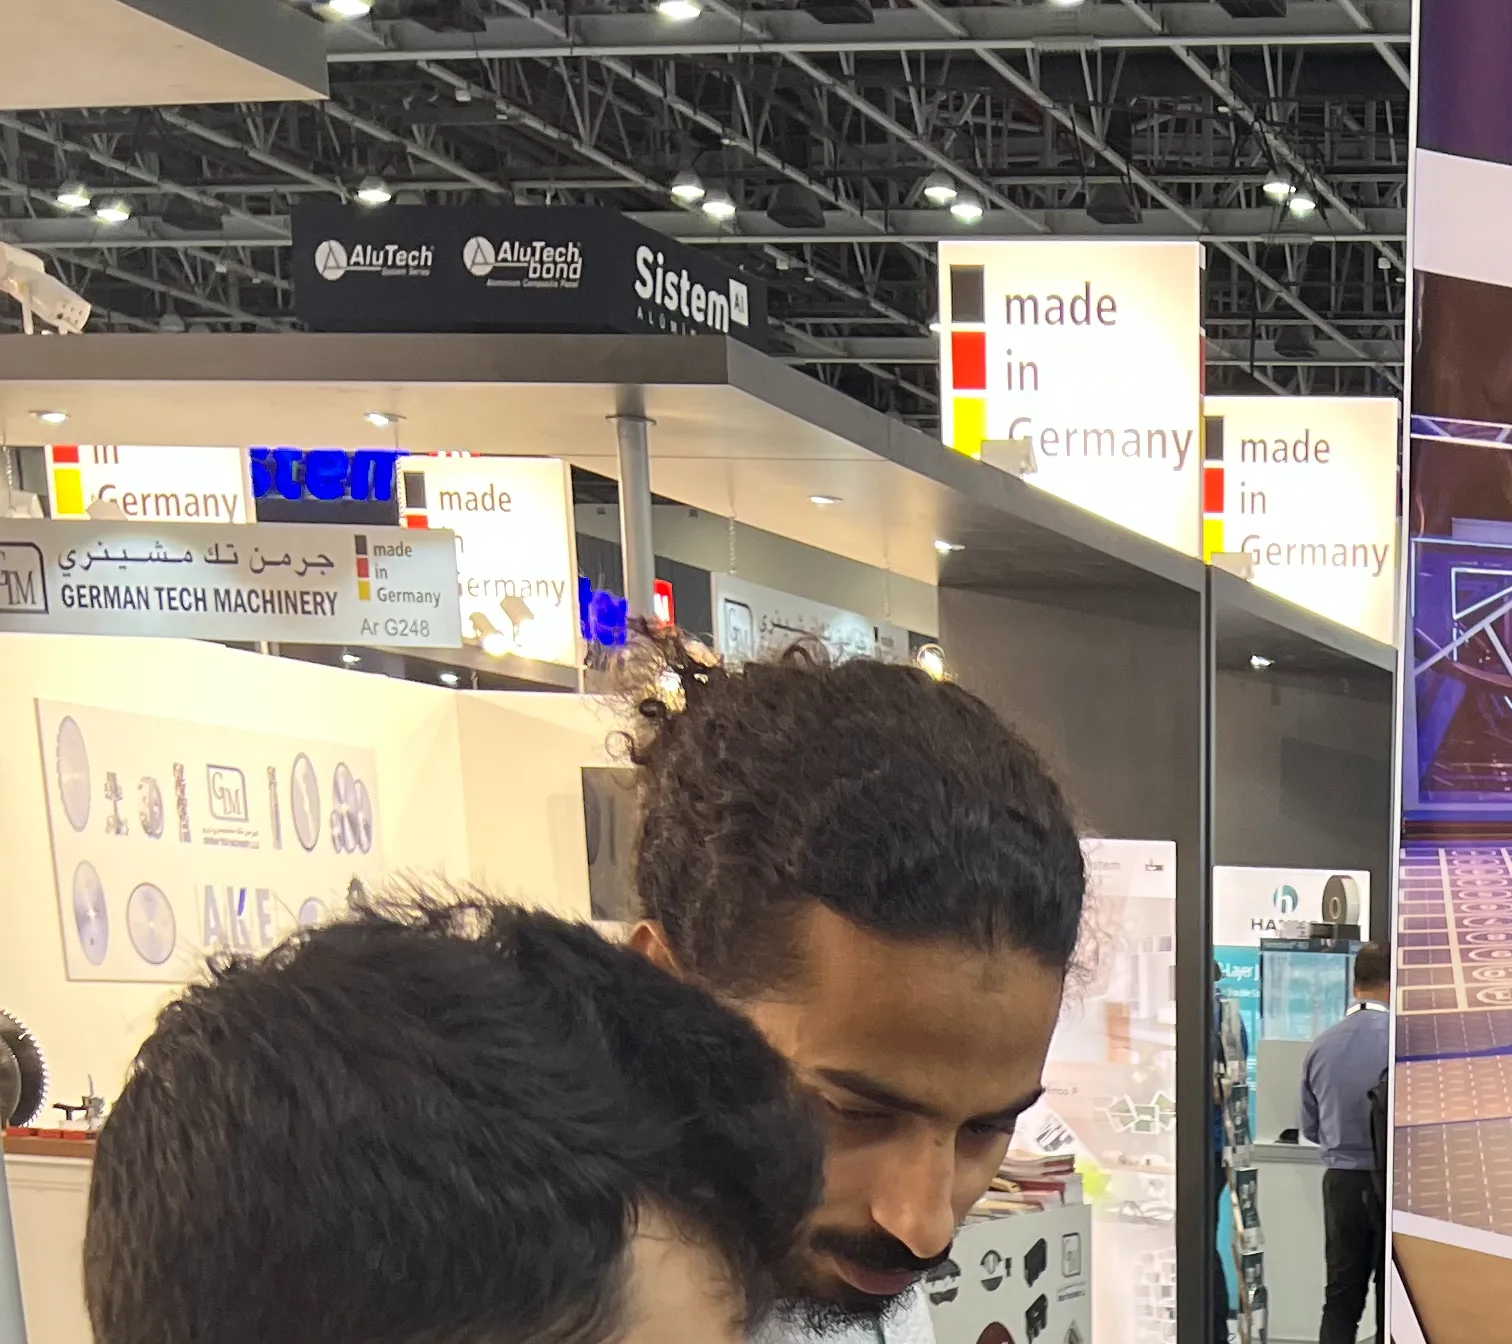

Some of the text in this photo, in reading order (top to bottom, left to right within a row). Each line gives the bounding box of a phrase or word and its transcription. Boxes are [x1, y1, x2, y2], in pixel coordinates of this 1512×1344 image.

[349, 244, 432, 267] AluTech
[497, 240, 581, 263] AluTech
[528, 257, 582, 279] bond
[634, 245, 730, 333] Sistem
[1004, 281, 1118, 326] made
[1005, 348, 1039, 391] in
[1239, 429, 1331, 464] made
[439, 483, 512, 512] made
[1239, 481, 1267, 515] in
[57, 540, 334, 577] جرمن تك مشينري
[373, 541, 413, 557] made
[1240, 535, 1390, 577] Germany
[374, 564, 388, 580] in
[61, 584, 338, 616] GERMAN TECH MACHINERY
[376, 587, 441, 608] Germany
[458, 577, 565, 607] ermany
[360, 618, 430, 637] Ar G248
